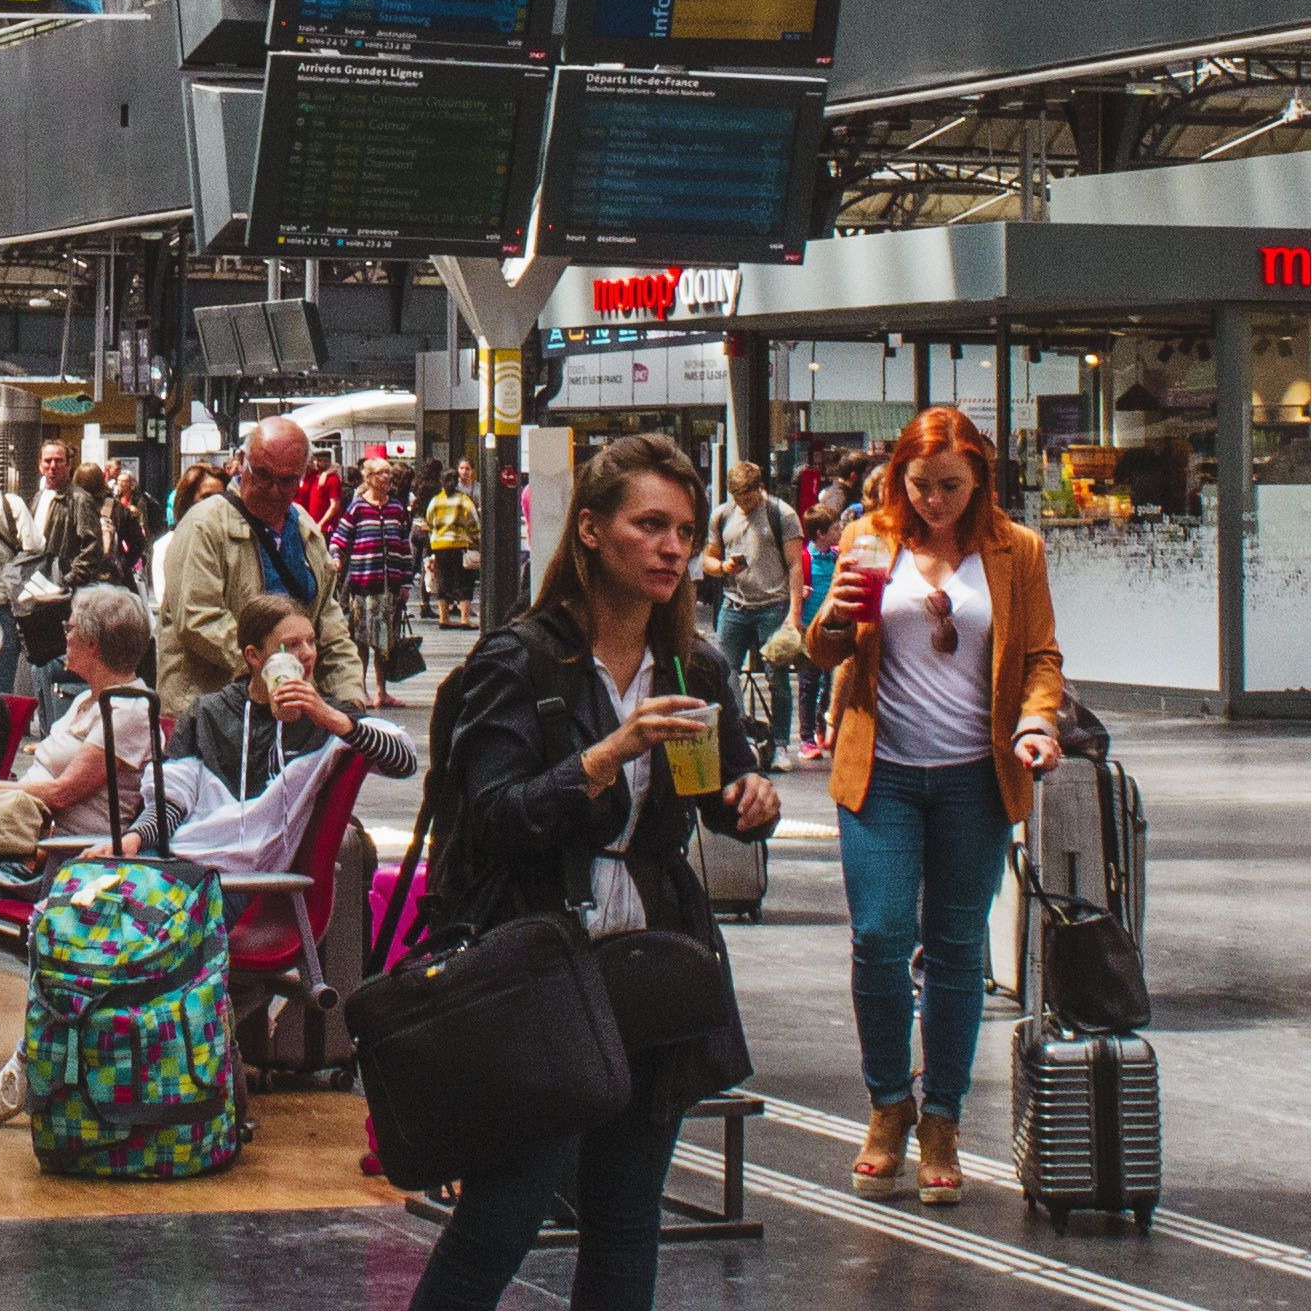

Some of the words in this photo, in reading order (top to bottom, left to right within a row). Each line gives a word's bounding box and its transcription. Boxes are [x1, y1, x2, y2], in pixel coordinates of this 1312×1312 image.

[376, 30, 418, 41] destination
[298, 62, 342, 75] Arrivées
[344, 65, 388, 77] Grandes
[390, 67, 424, 80] Lignes
[586, 73, 627, 87] Départs
